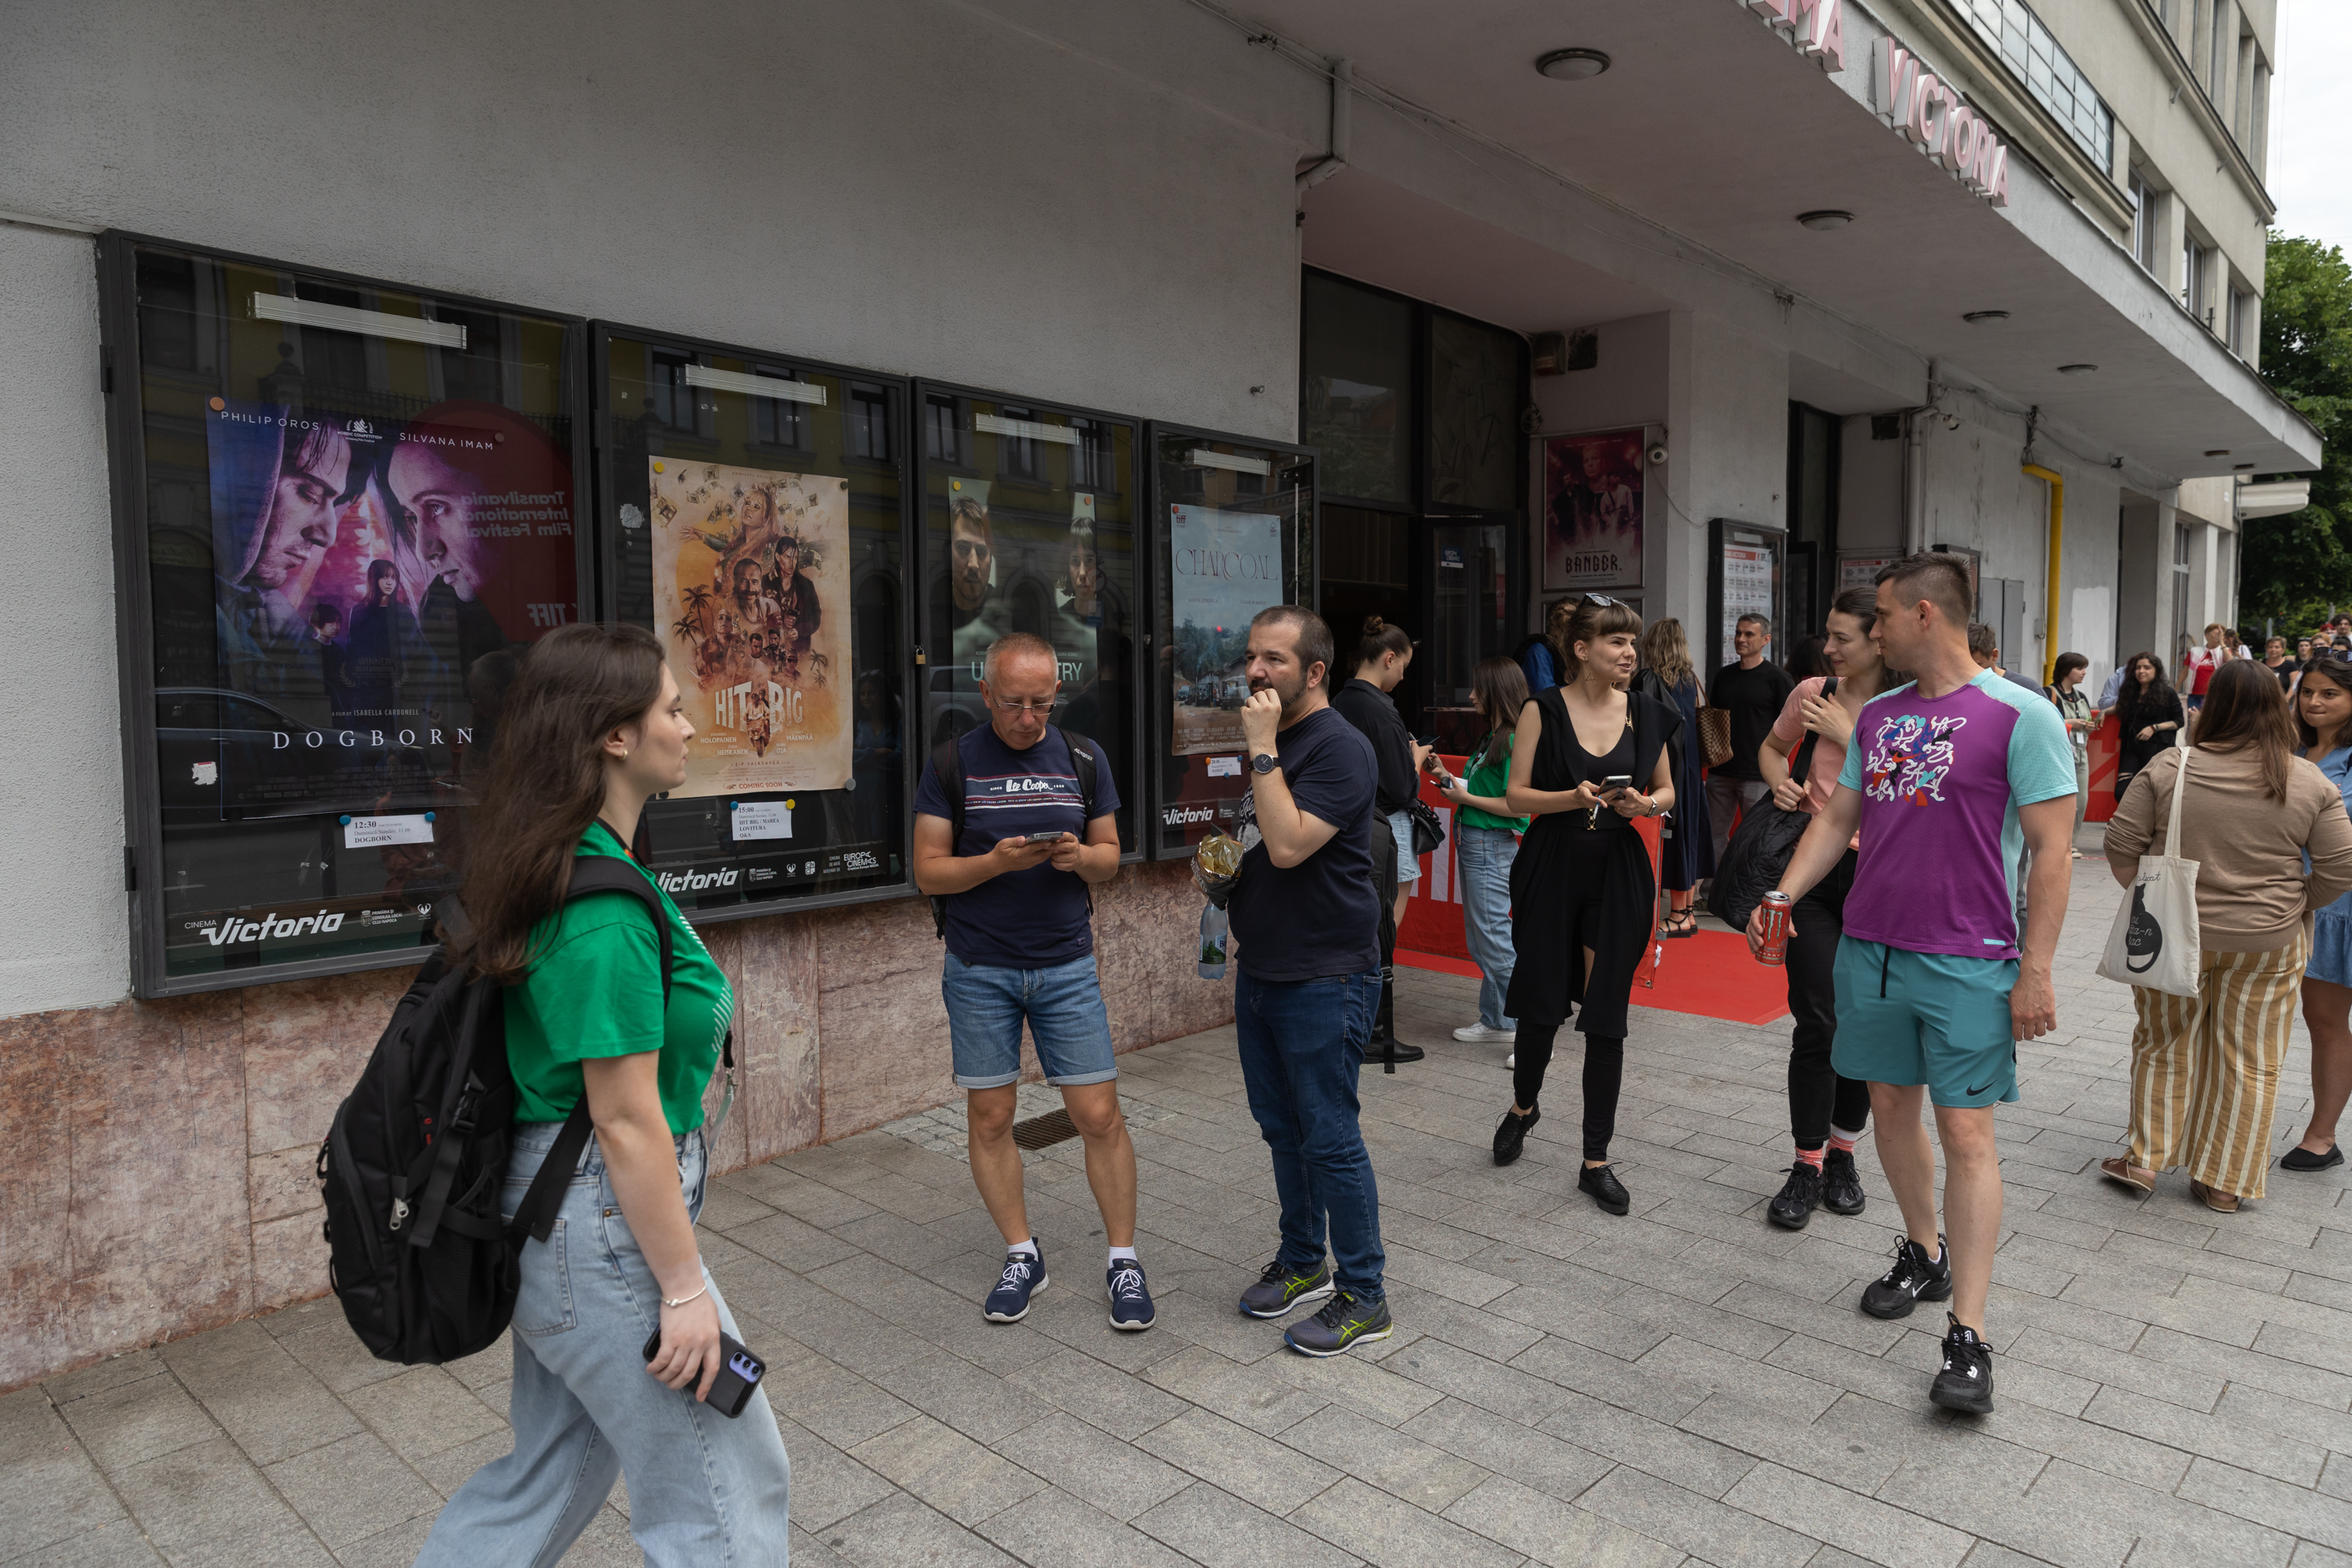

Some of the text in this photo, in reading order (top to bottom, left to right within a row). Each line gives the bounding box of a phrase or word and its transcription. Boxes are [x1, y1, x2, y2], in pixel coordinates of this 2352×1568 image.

[1878, 36, 2008, 207] VICTORIA
[221, 412, 319, 431] PHILIP OROS
[399, 432, 493, 451] SILVANA IMAM
[1176, 548, 1278, 581] CHARCOAL
[358, 658, 391, 666] WINNER
[1058, 663, 1083, 681] TRY
[716, 681, 752, 733] HIT
[767, 680, 803, 734] BIG
[273, 727, 474, 749] DOGBORN
[1005, 779, 1021, 792] Lee
[1022, 779, 1053, 793] Cooper
[354, 821, 376, 829] 12:30
[1163, 806, 1214, 825] Victoria
[354, 835, 392, 843] DOGBORN
[843, 851, 871, 861] EUROPA
[847, 857, 877, 868] CINEMAS
[184, 920, 217, 930] CINEMA
[199, 909, 345, 947] Victoria
